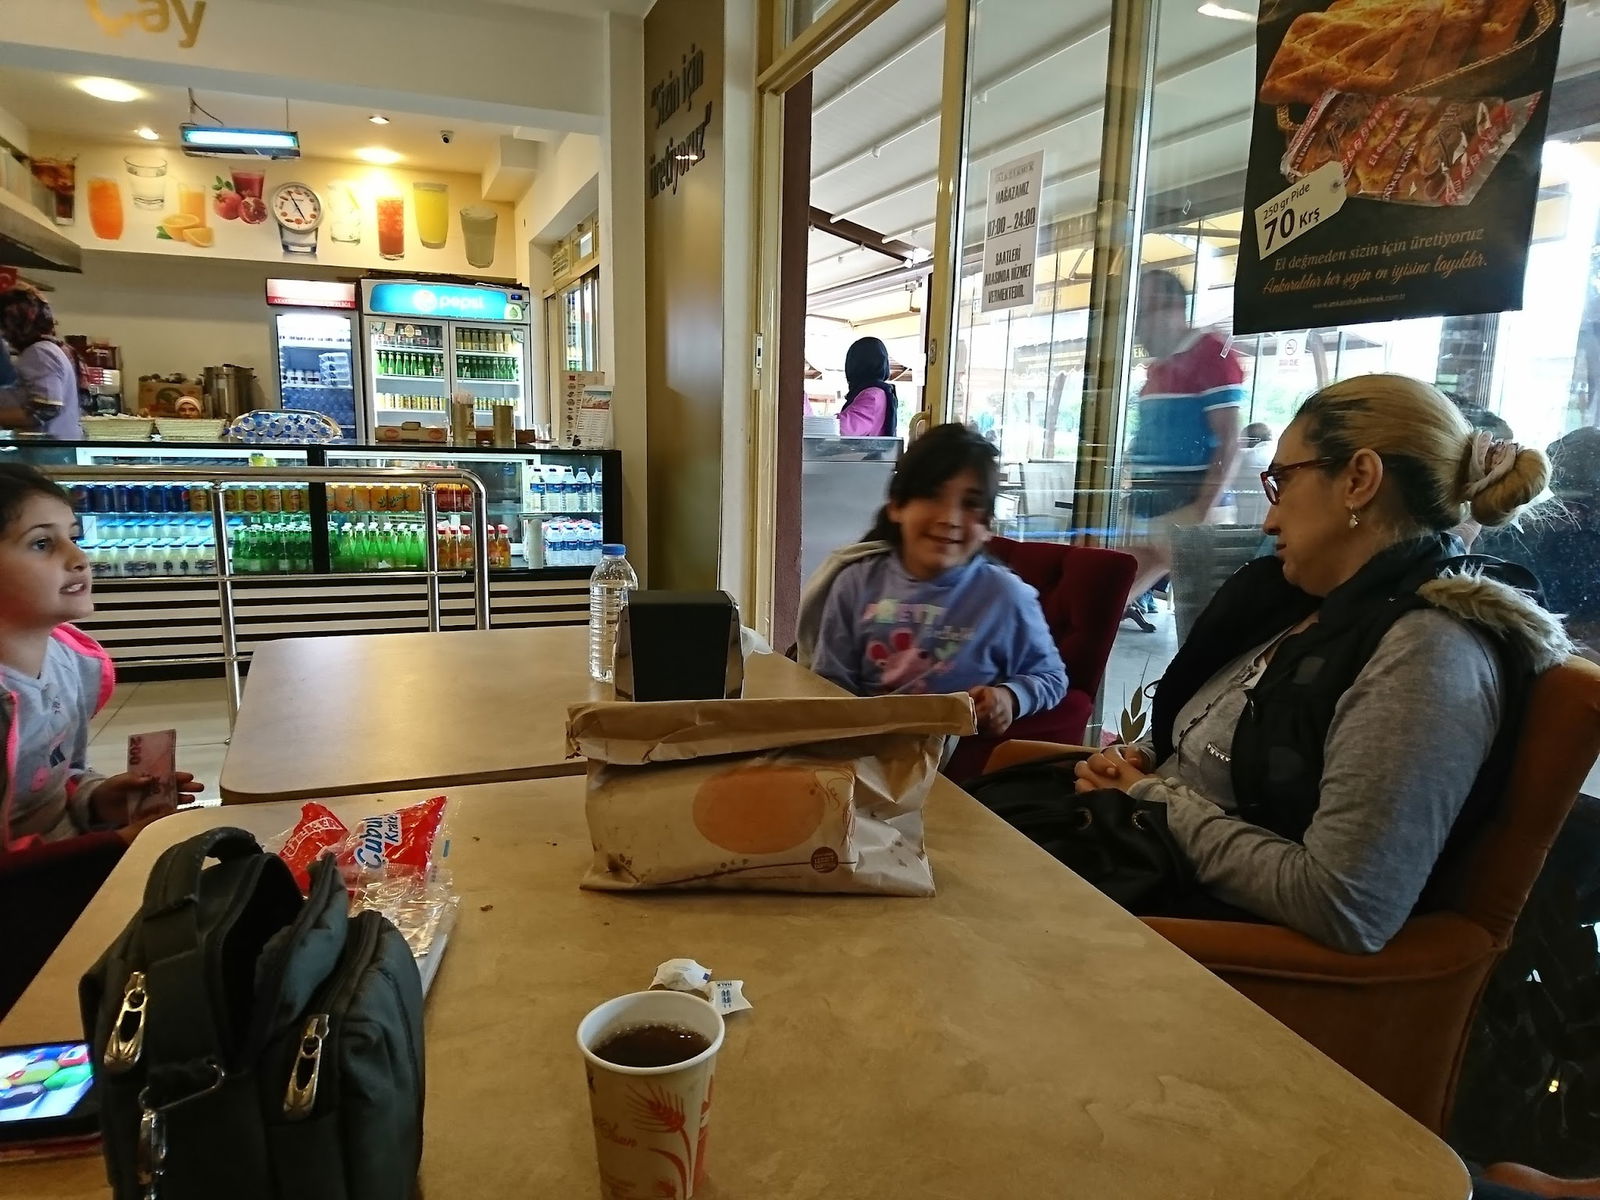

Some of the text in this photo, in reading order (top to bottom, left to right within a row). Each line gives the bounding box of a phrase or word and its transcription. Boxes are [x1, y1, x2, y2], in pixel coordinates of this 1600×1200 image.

[987, 216, 1006, 237] 07:00
[1014, 207, 1036, 229] 24:00
[1263, 183, 1310, 220] 250 gr Pide
[1264, 207, 1320, 251] 70 Krş
[1274, 228, 1485, 271] El değmeden sizin için üretiyoruz
[357, 816, 386, 869] Çubu
